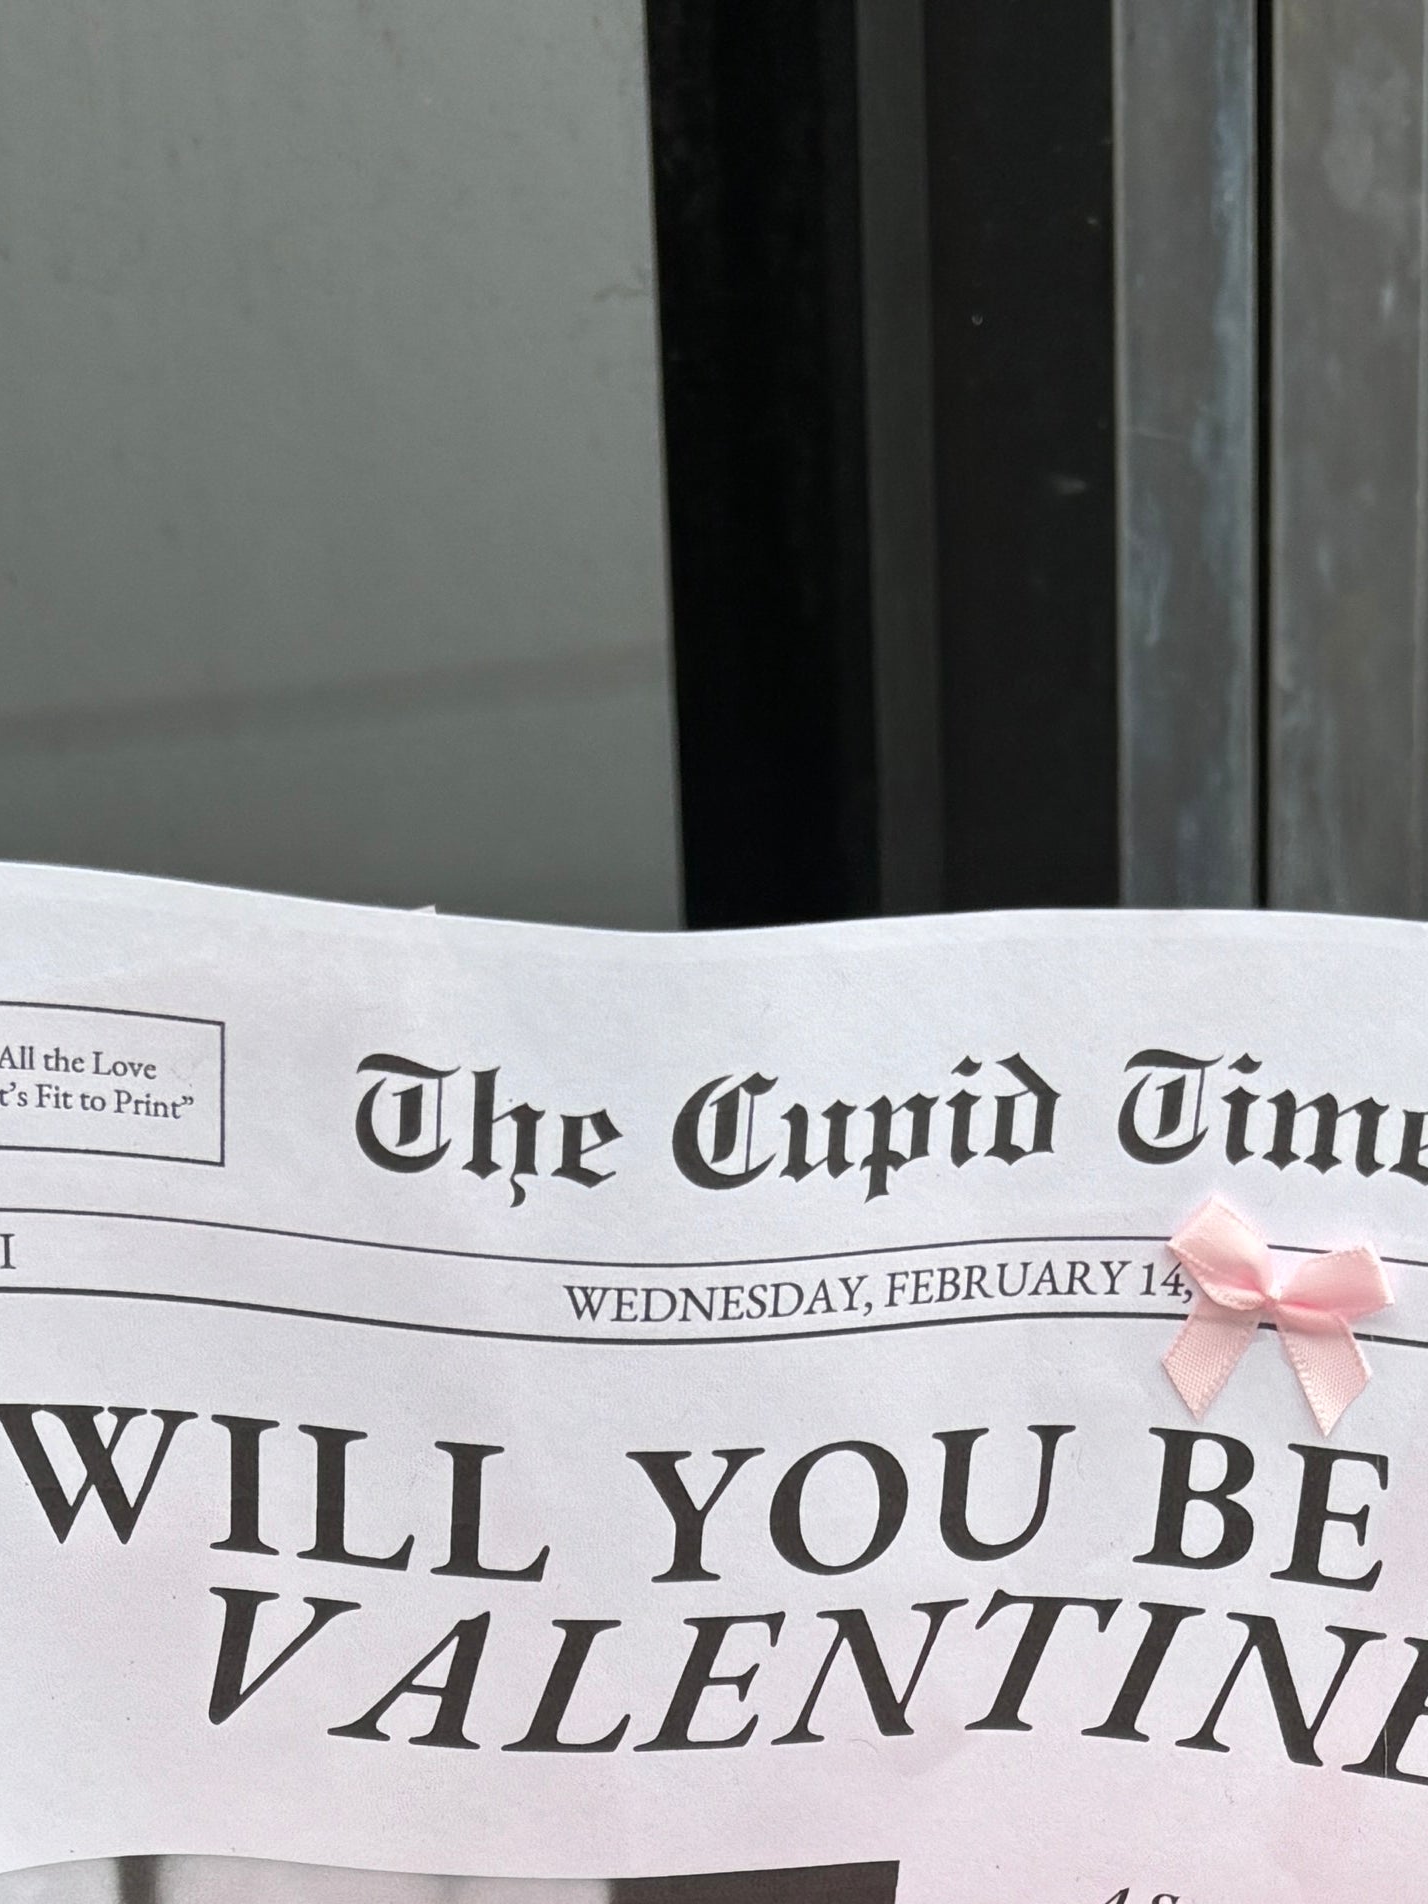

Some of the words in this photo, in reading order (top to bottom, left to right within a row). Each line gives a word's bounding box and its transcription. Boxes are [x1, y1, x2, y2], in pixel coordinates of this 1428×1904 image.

[43, 1048, 85, 1073] the
[92, 1051, 158, 1080] Love
[35, 1084, 73, 1109] Fit
[80, 1091, 106, 1112] to
[355, 1053, 623, 1208] The
[672, 1052, 1062, 1203] Cupid
[0, 1234, 17, 1270] I
[563, 1274, 874, 1324] WEDNESDAY,
[885, 1259, 1131, 1307] FEBRUARY
[625, 1424, 1077, 1584] YOU
[1131, 1425, 1390, 1594] BE
